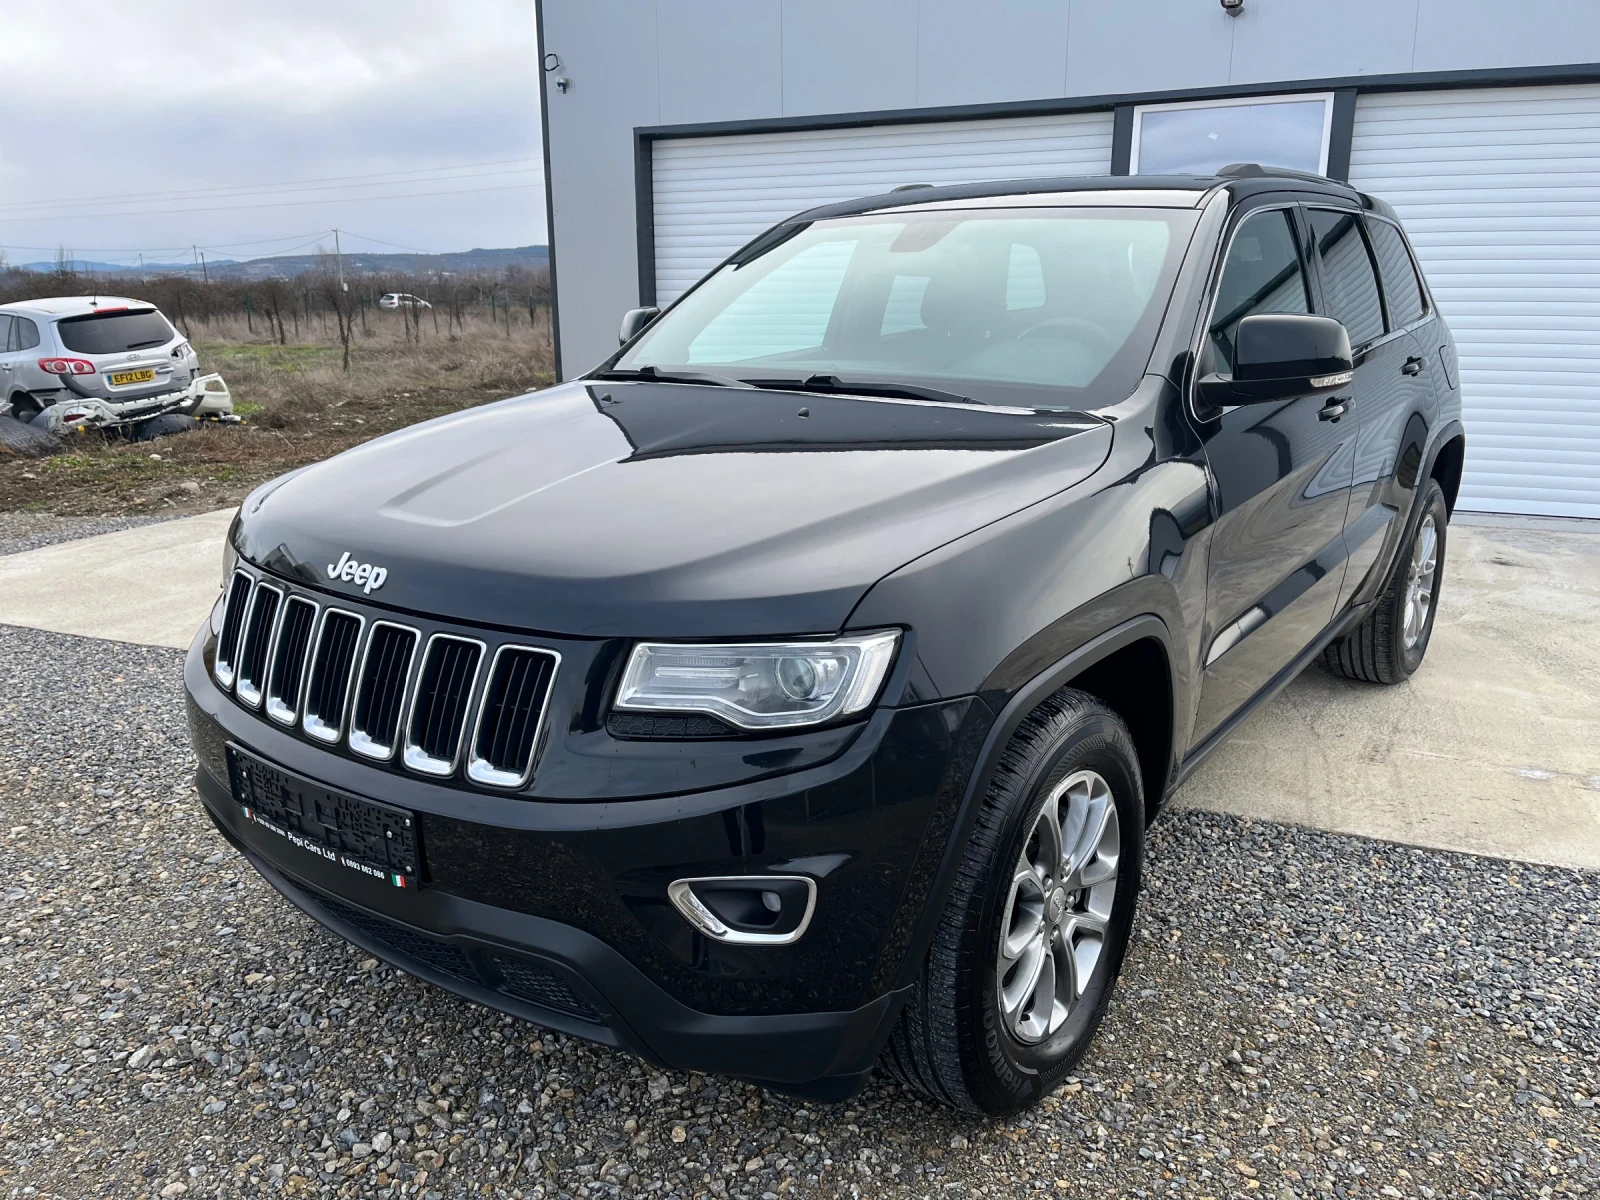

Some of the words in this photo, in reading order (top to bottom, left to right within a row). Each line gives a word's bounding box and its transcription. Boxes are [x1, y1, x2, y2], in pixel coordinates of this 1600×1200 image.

[113, 373, 134, 384] EF12
[134, 370, 152, 381] LBG
[327, 551, 388, 595] Jeep
[287, 831, 304, 847] Pepi
[304, 840, 322, 855] Cars
[322, 848, 336, 861] Ltd
